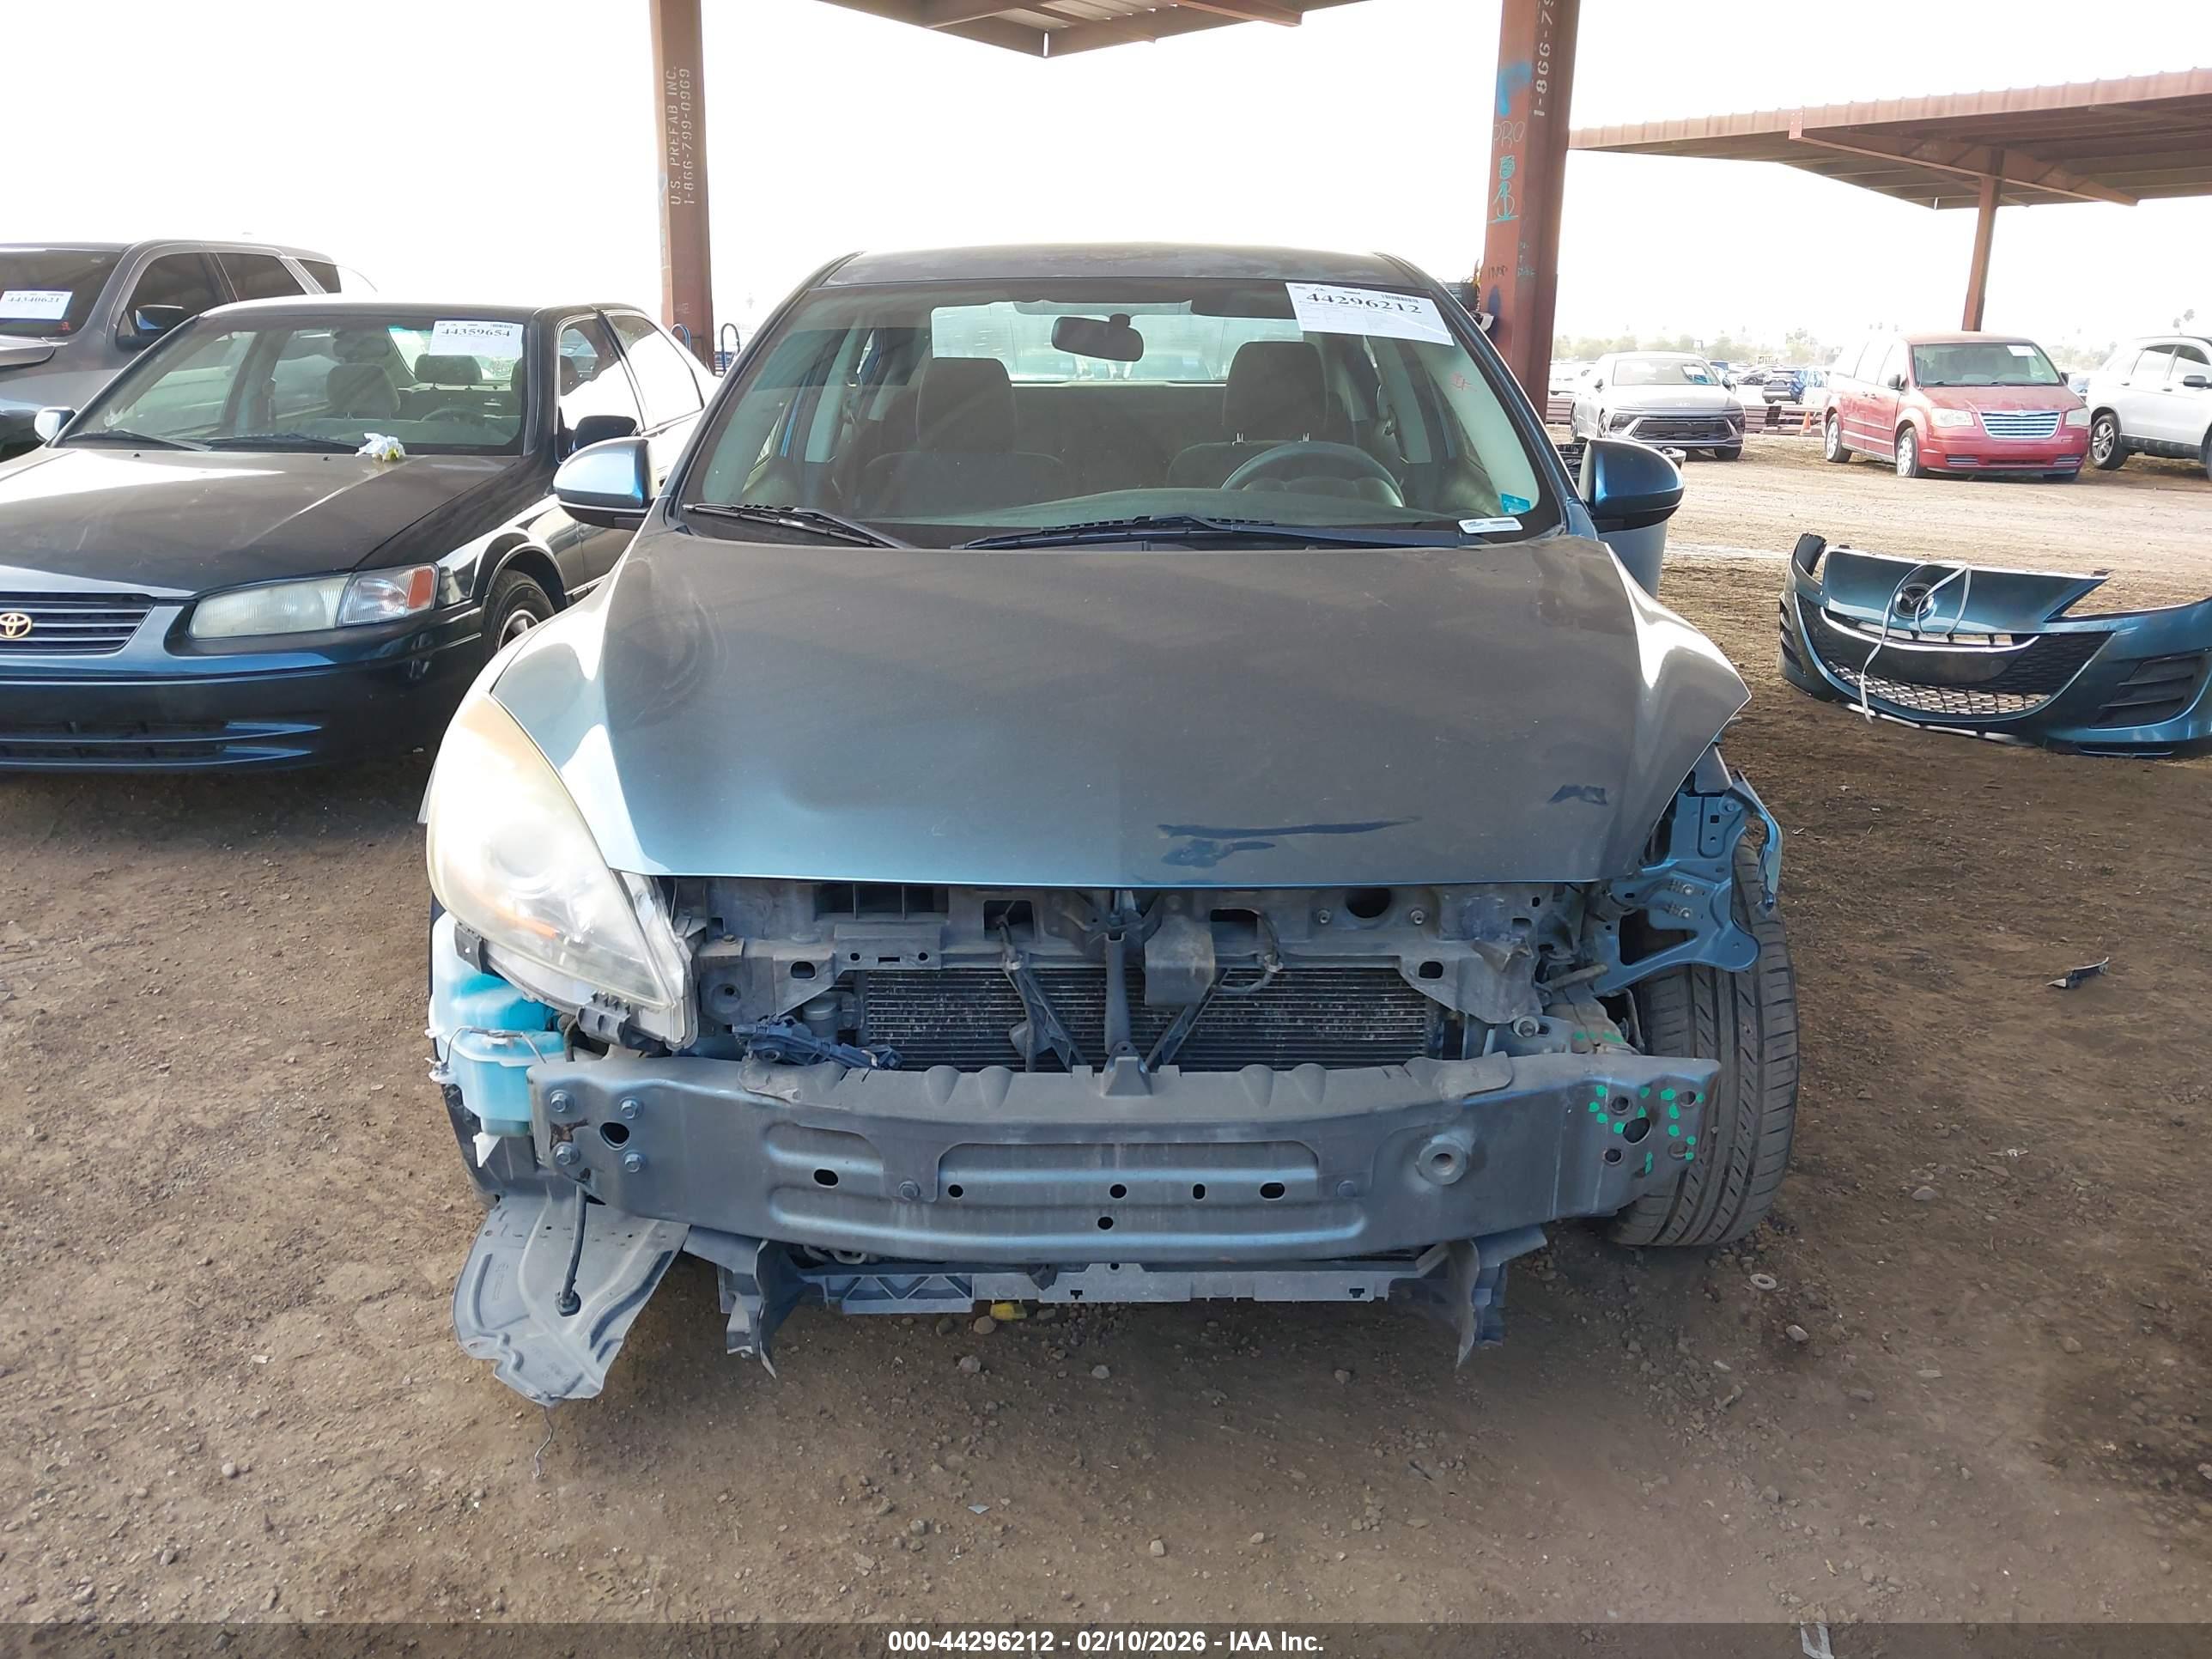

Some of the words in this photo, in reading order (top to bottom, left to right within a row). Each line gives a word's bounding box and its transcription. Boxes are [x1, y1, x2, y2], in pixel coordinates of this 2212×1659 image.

[665, 66, 678, 96] INC.
[667, 105, 681, 167] PREFAB
[678, 68, 695, 204] 1-866-799-0969
[670, 176, 682, 206] U.S.
[1306, 292, 1423, 314] 44296212
[441, 328, 511, 337] 44359654
